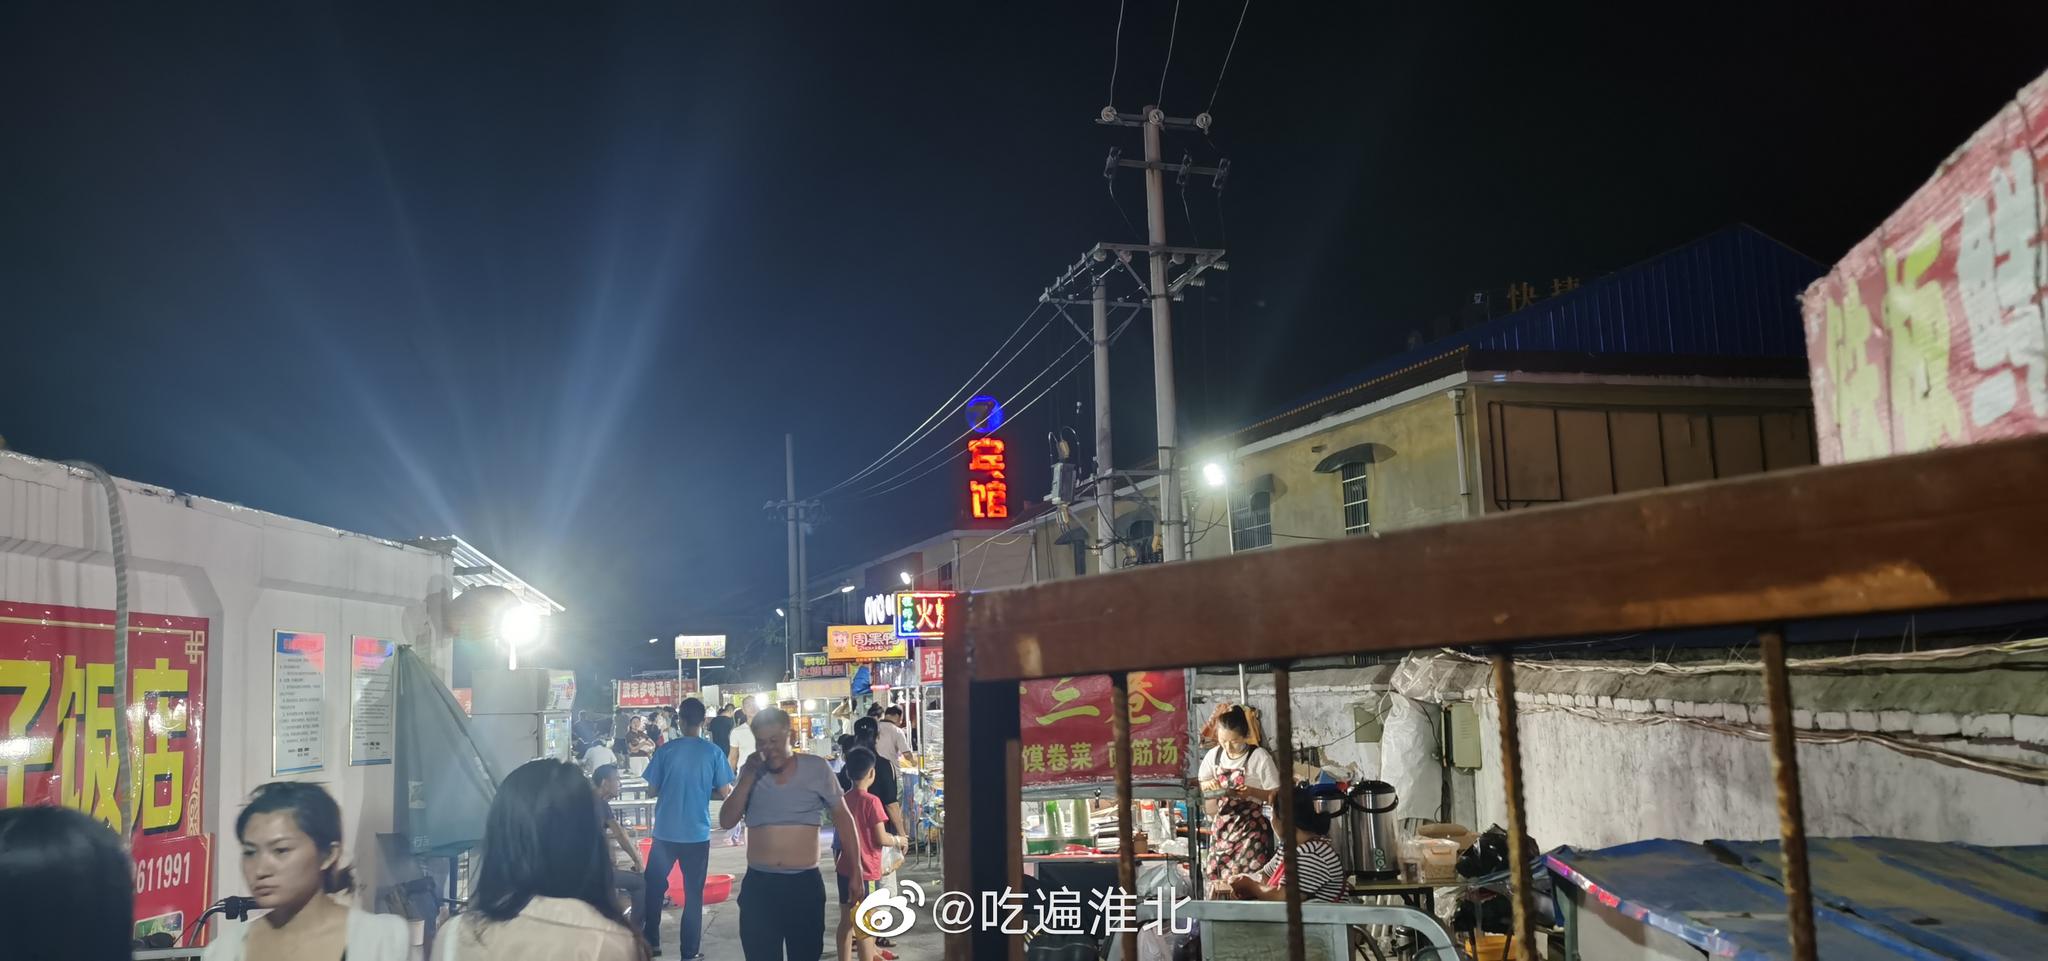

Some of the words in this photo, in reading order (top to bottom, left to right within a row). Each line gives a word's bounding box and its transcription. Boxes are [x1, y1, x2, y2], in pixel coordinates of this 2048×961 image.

[968, 438, 1007, 518] 宾馆
[852, 632, 900, 647] 周黑鸭
